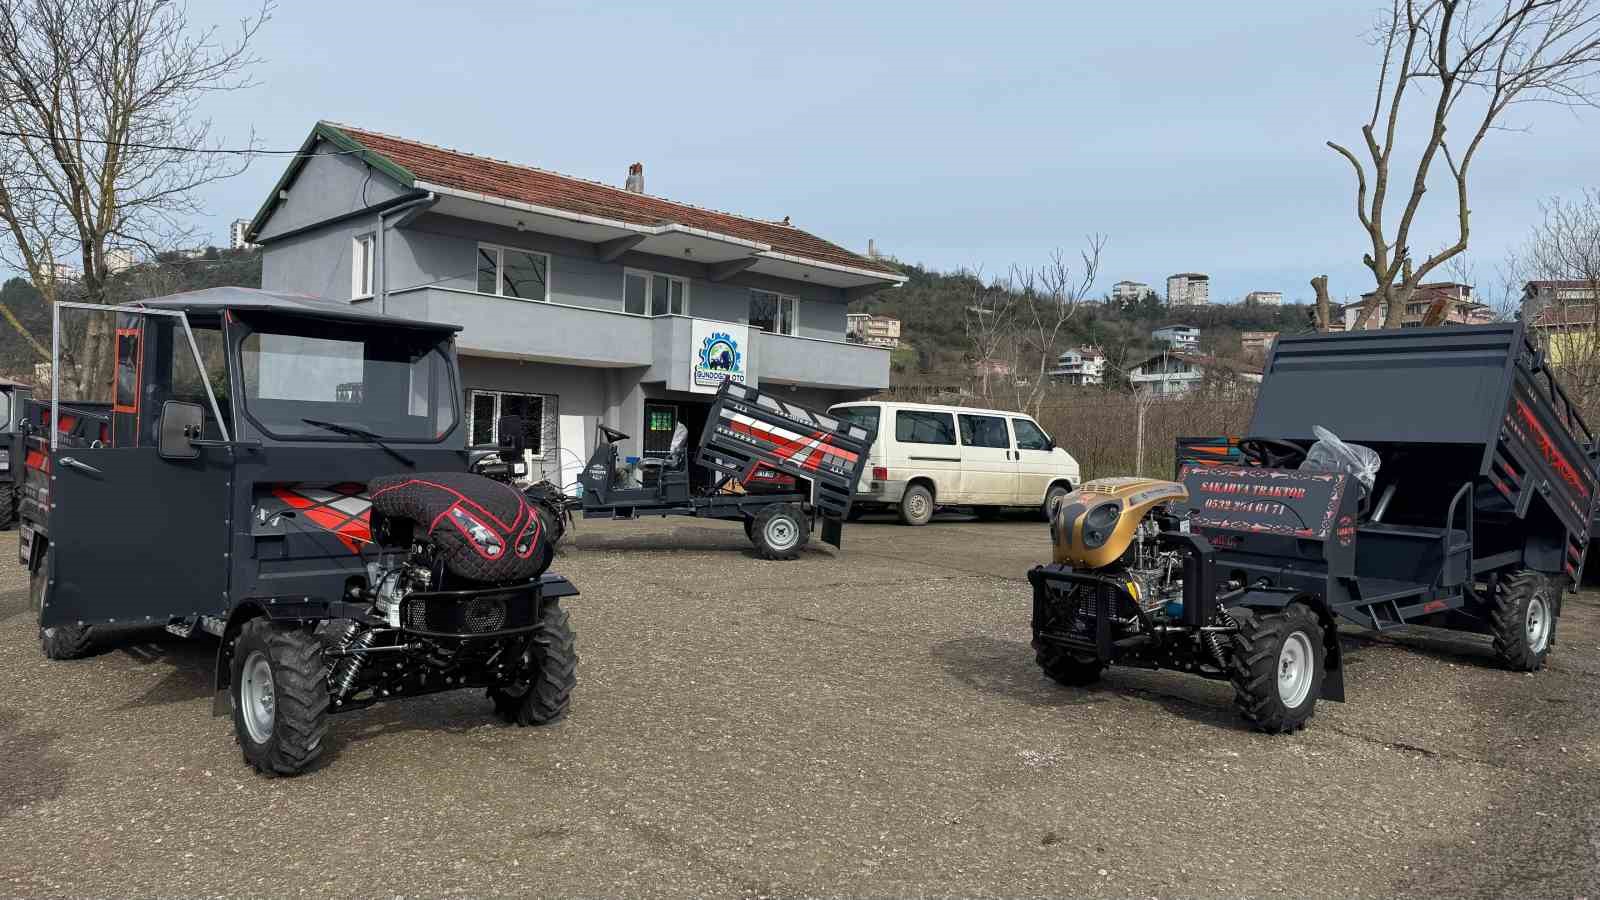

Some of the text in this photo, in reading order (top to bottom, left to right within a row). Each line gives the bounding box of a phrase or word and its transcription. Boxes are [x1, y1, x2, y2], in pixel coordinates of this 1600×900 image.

[732, 374, 744, 382] OTO
[1200, 481, 1248, 494] SAKARYA
[1253, 484, 1306, 498] TRAKTOR
